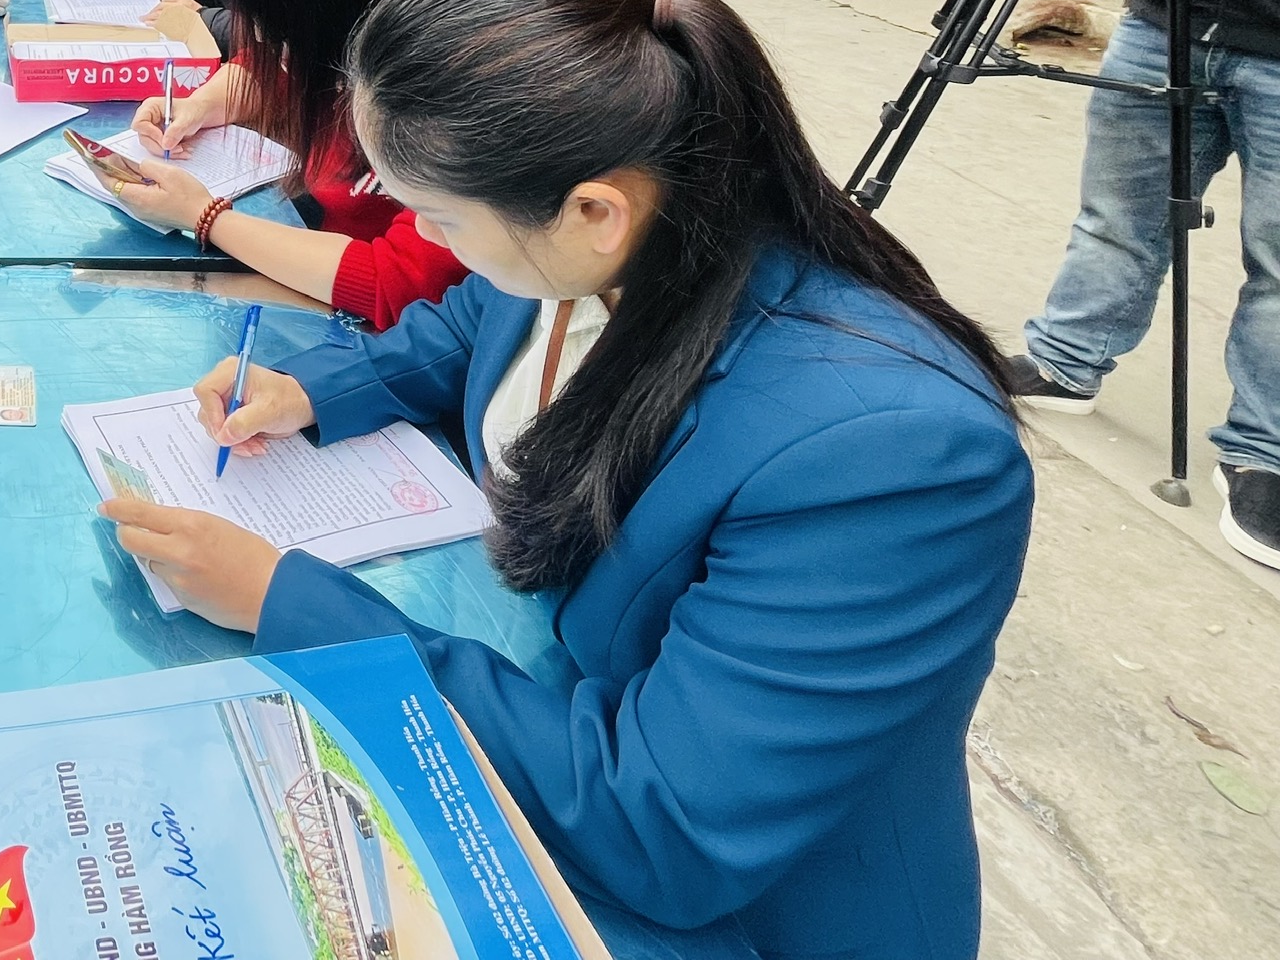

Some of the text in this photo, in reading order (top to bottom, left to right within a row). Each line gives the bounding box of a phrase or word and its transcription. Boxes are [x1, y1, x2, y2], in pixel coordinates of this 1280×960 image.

[55, 761, 90, 837] UBMTTQ
[104, 821, 136, 879] RỒNG
[77, 856, 108, 915] UBND
[120, 885, 151, 935] HÀM
